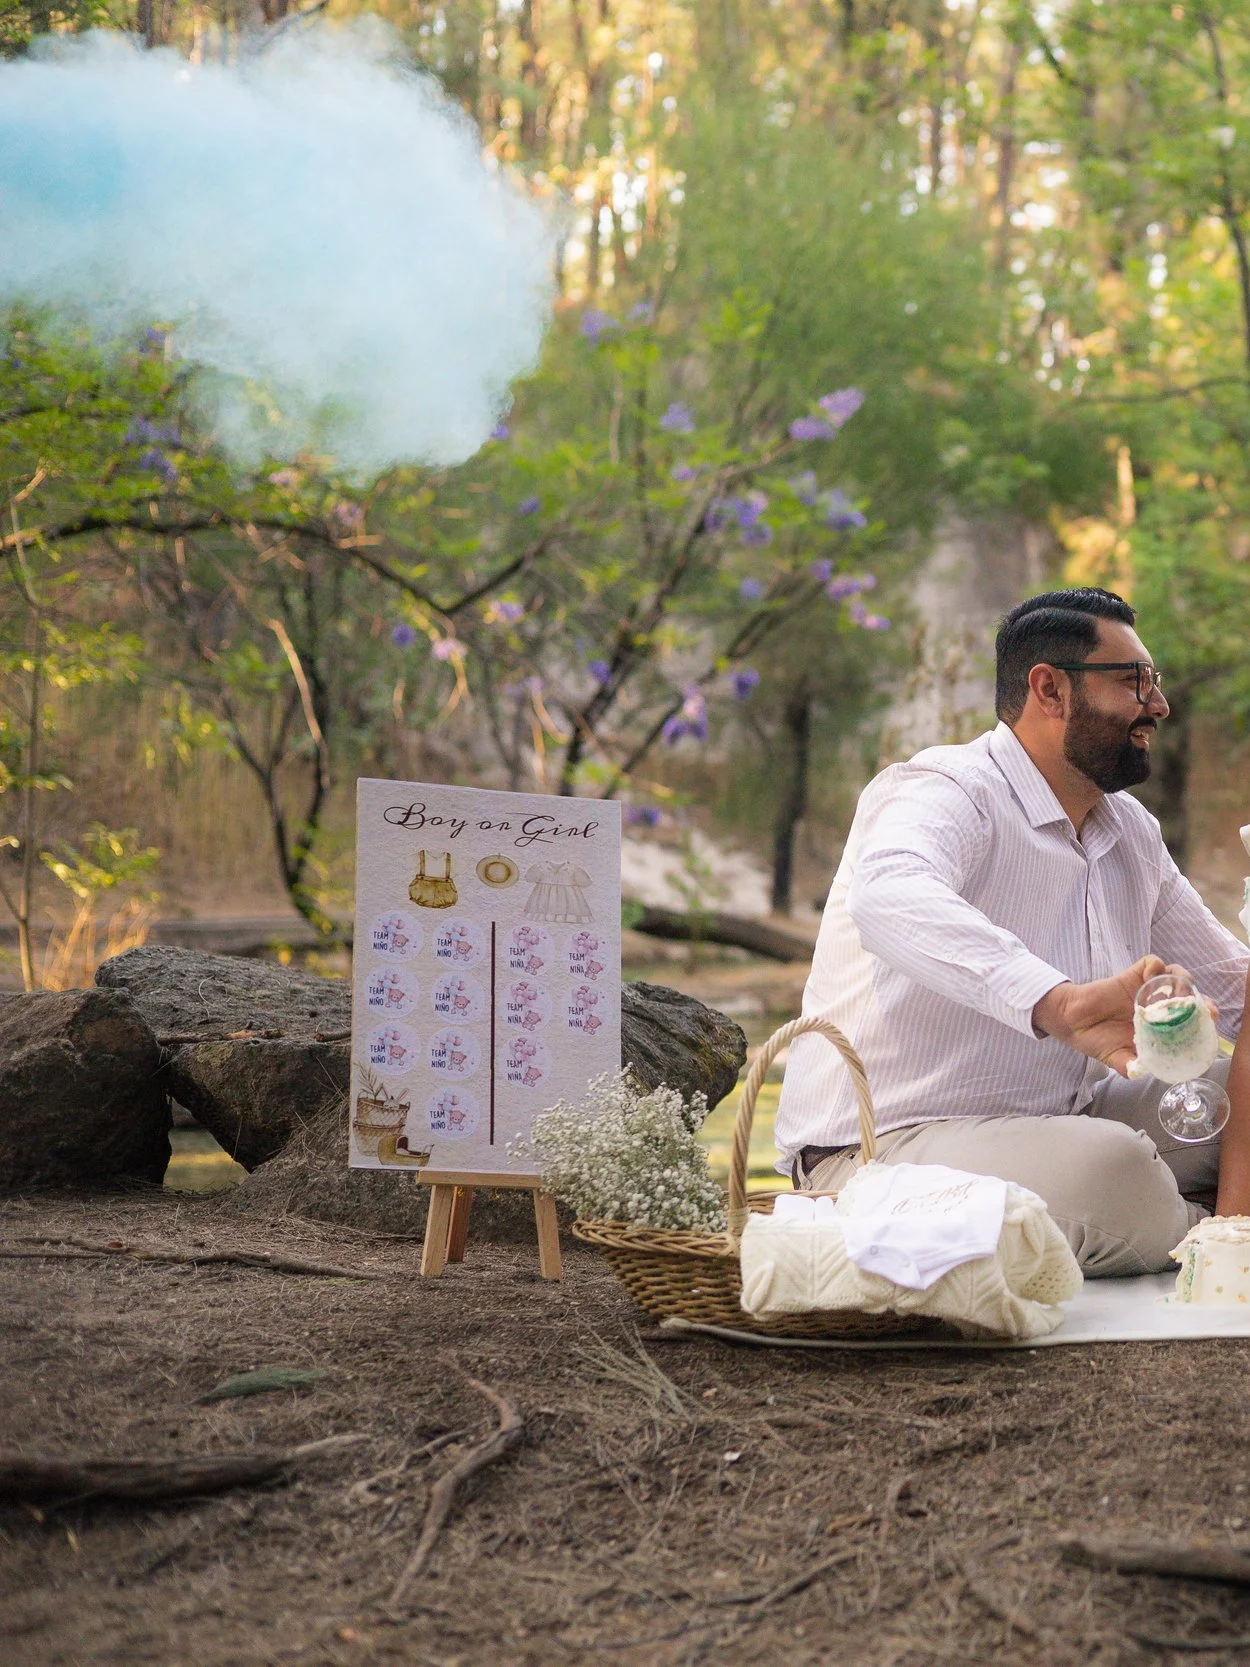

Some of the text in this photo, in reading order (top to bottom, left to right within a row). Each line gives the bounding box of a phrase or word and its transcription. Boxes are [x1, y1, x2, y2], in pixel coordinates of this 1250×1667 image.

[383, 802, 599, 847] Boy or Girl
[373, 931, 389, 939] TEAM
[373, 941, 388, 951] NIÑO
[437, 938, 452, 947] TEAM
[436, 948, 452, 958] NIÑO
[509, 947, 525, 956] TEAM
[569, 952, 585, 961] TEAM
[510, 959, 525, 968] NIÑA
[570, 964, 584, 974] NIÑA
[369, 986, 384, 995] TEAM
[435, 992, 450, 1001] TEAM
[368, 997, 384, 1006] NIÑO
[434, 1003, 449, 1012] NIÑO
[507, 1003, 523, 1011] TEAM
[568, 1006, 584, 1015] TEAM
[507, 1015, 522, 1024] NIÑA
[568, 1018, 583, 1028] NIÑA
[370, 1044, 385, 1053] TEAM
[431, 1049, 446, 1058] TEAM
[371, 1054, 386, 1064] NIÑO
[431, 1060, 446, 1069] NIÑO
[506, 1060, 523, 1068] TEAM
[507, 1071, 523, 1081] NIÑA
[430, 1110, 445, 1119] TEAM
[430, 1121, 446, 1130] NIÑO
